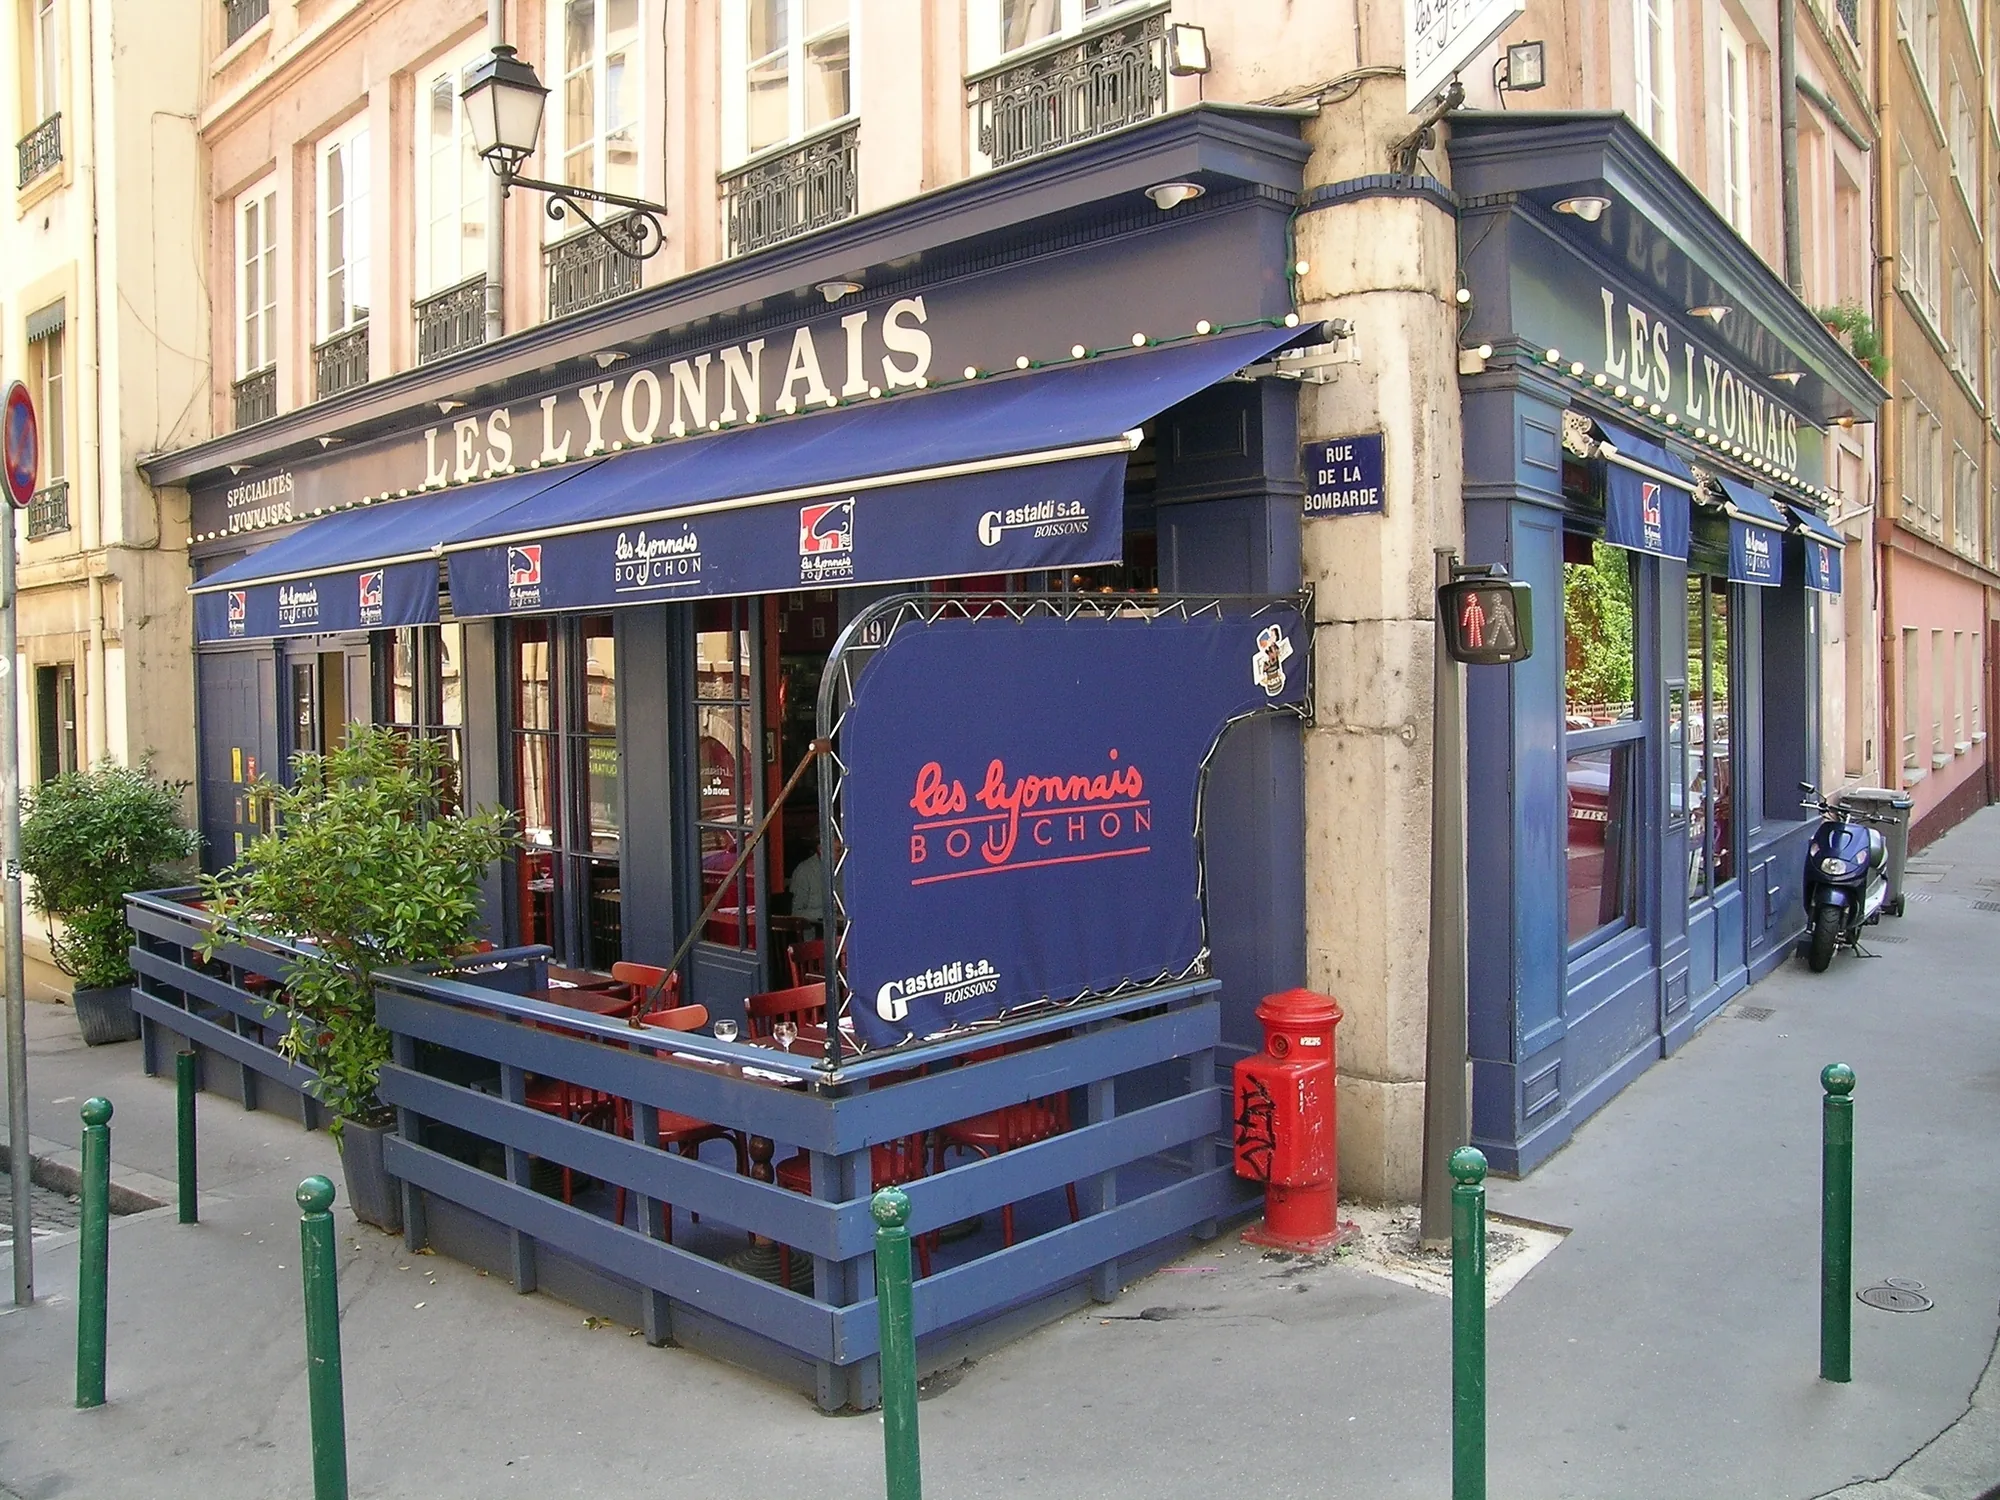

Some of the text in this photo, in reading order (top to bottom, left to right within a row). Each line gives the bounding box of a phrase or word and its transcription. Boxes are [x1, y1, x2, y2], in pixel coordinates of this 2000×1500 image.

[421, 295, 935, 492] LES LYONNAIS
[1601, 286, 1798, 473] LES LYONNAIS
[1326, 444, 1354, 464] RUE
[227, 468, 292, 509] SPÉCIALITÉS
[1318, 465, 1362, 486] DE LA
[228, 501, 293, 532] LYONNAISES
[1303, 487, 1379, 512] BOMBARDE
[978, 500, 1086, 547] Gastaldi s.a.
[1034, 521, 1089, 539] BOISSONS
[615, 522, 698, 586] les lyonnais
[615, 557, 701, 583] BOUCHON
[862, 620, 882, 644] 19
[910, 748, 1144, 865] les lyonnais
[910, 807, 1151, 865] BOUCHON
[876, 959, 994, 1021] Gastaldi s.a.
[943, 979, 998, 1005] BOISSONS
